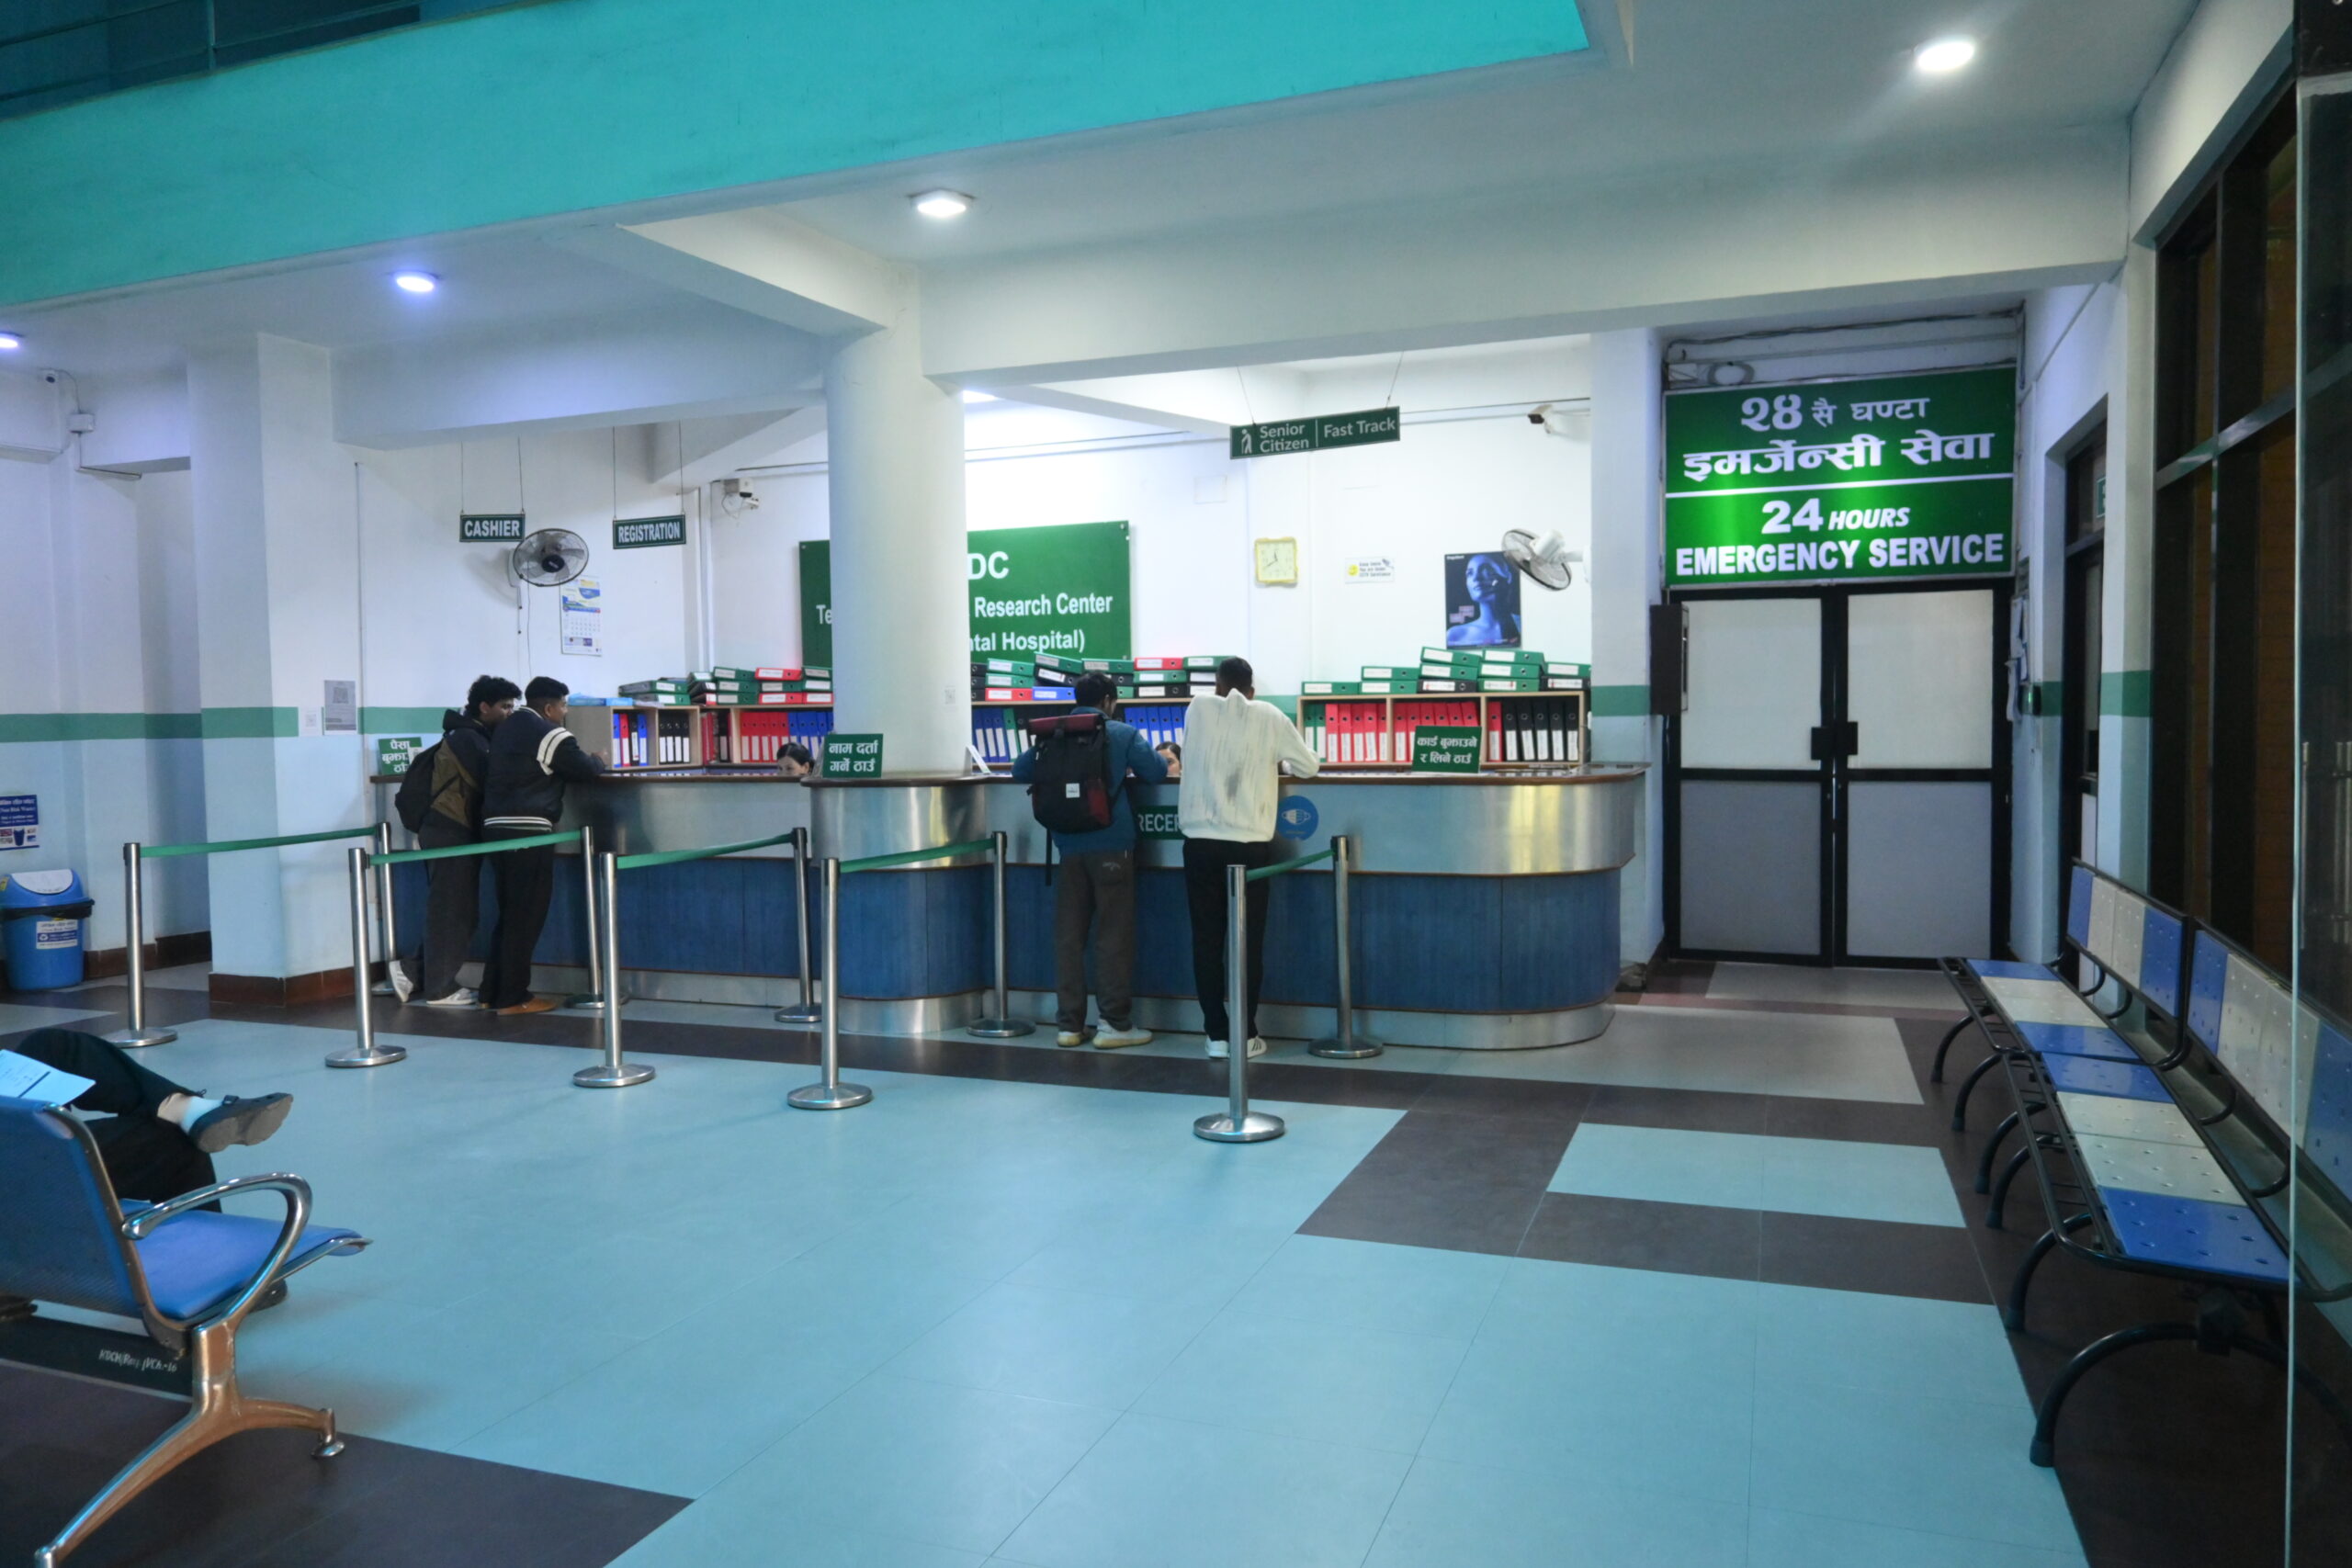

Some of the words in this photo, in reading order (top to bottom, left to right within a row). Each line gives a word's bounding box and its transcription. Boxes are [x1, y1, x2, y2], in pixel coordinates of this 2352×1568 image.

[1741, 394, 1803, 432] २४
[1811, 398, 1838, 427] सै
[1849, 398, 1930, 422] घण्टा
[1260, 423, 1306, 439] Senior
[1324, 423, 1353, 438] Fast
[1356, 417, 1396, 434] Track
[1260, 437, 1309, 453] Citizen
[1683, 433, 1885, 482] इमर्जेन्सी
[1901, 429, 1996, 465] सेवा
[1761, 498, 1824, 534] 24
[1828, 507, 1910, 531] HOURS
[464, 520, 520, 537] CASHIER
[618, 522, 681, 543] REGISTRATION
[967, 551, 1009, 580] DC
[1676, 539, 1860, 576] EMERGENCY
[1868, 534, 2004, 568] SERVICE
[975, 593, 1051, 617] Research
[1057, 592, 1113, 615] Center
[1002, 629, 1085, 653] Hospital)
[829, 742, 853, 754] नाम
[856, 739, 878, 754] दर्ता
[1419, 753, 1428, 762] र
